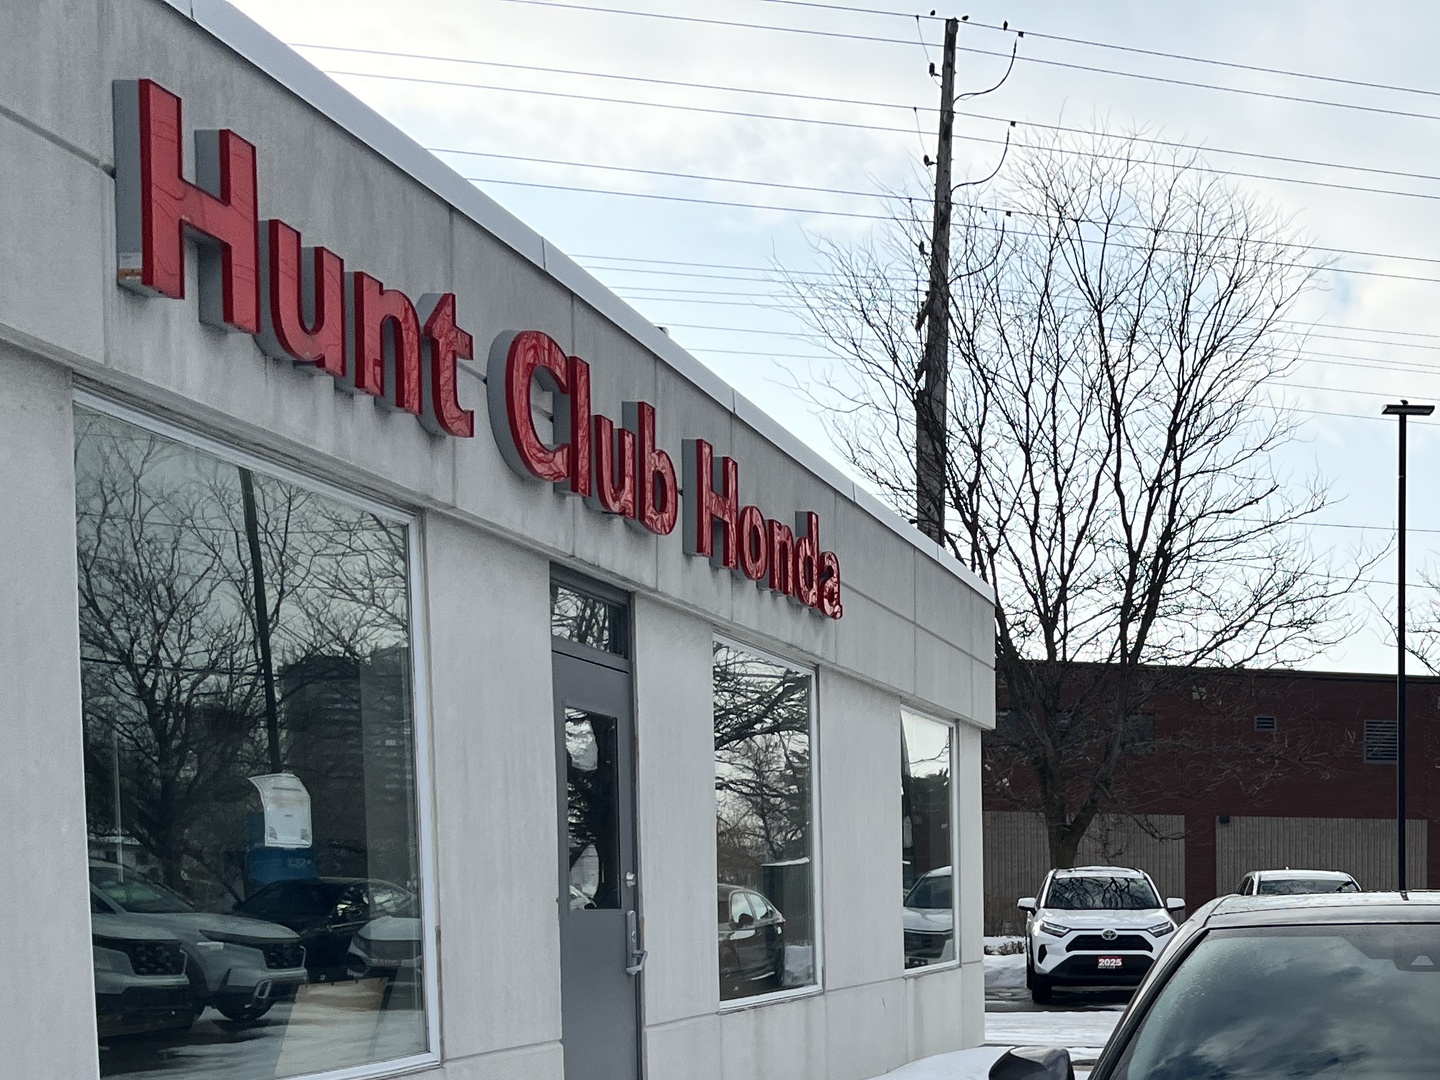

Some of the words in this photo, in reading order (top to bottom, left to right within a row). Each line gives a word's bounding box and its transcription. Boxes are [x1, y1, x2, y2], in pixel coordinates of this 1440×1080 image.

[136, 78, 474, 438] Hunt
[504, 330, 679, 537] Club
[693, 439, 844, 621] Honda
[1098, 958, 1122, 966] 2025
